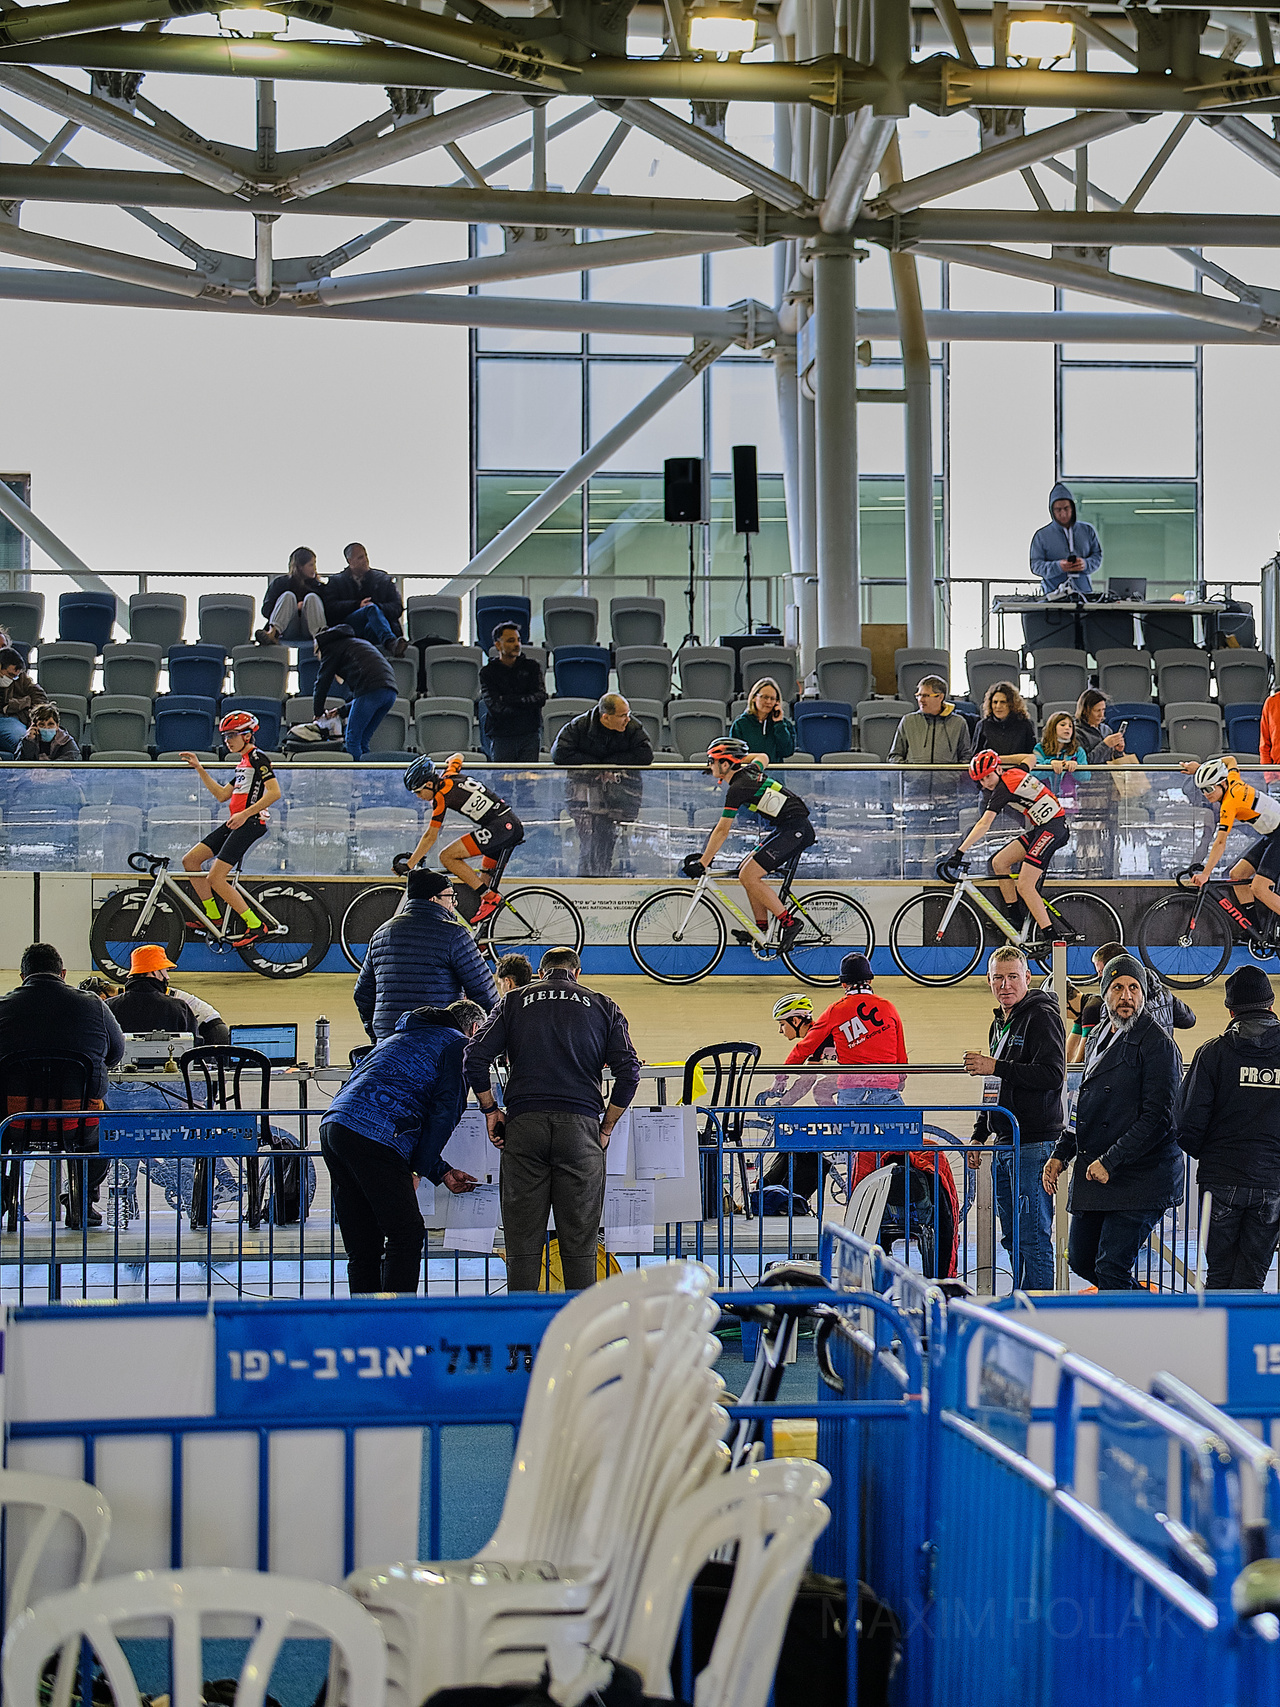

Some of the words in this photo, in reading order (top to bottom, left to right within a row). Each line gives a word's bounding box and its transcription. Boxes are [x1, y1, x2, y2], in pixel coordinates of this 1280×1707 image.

[470, 795, 487, 812] 30
[1037, 802, 1053, 819] 16
[258, 886, 314, 902] ICAN
[1218, 897, 1252, 930] BMC
[522, 990, 591, 1008] HELLAS
